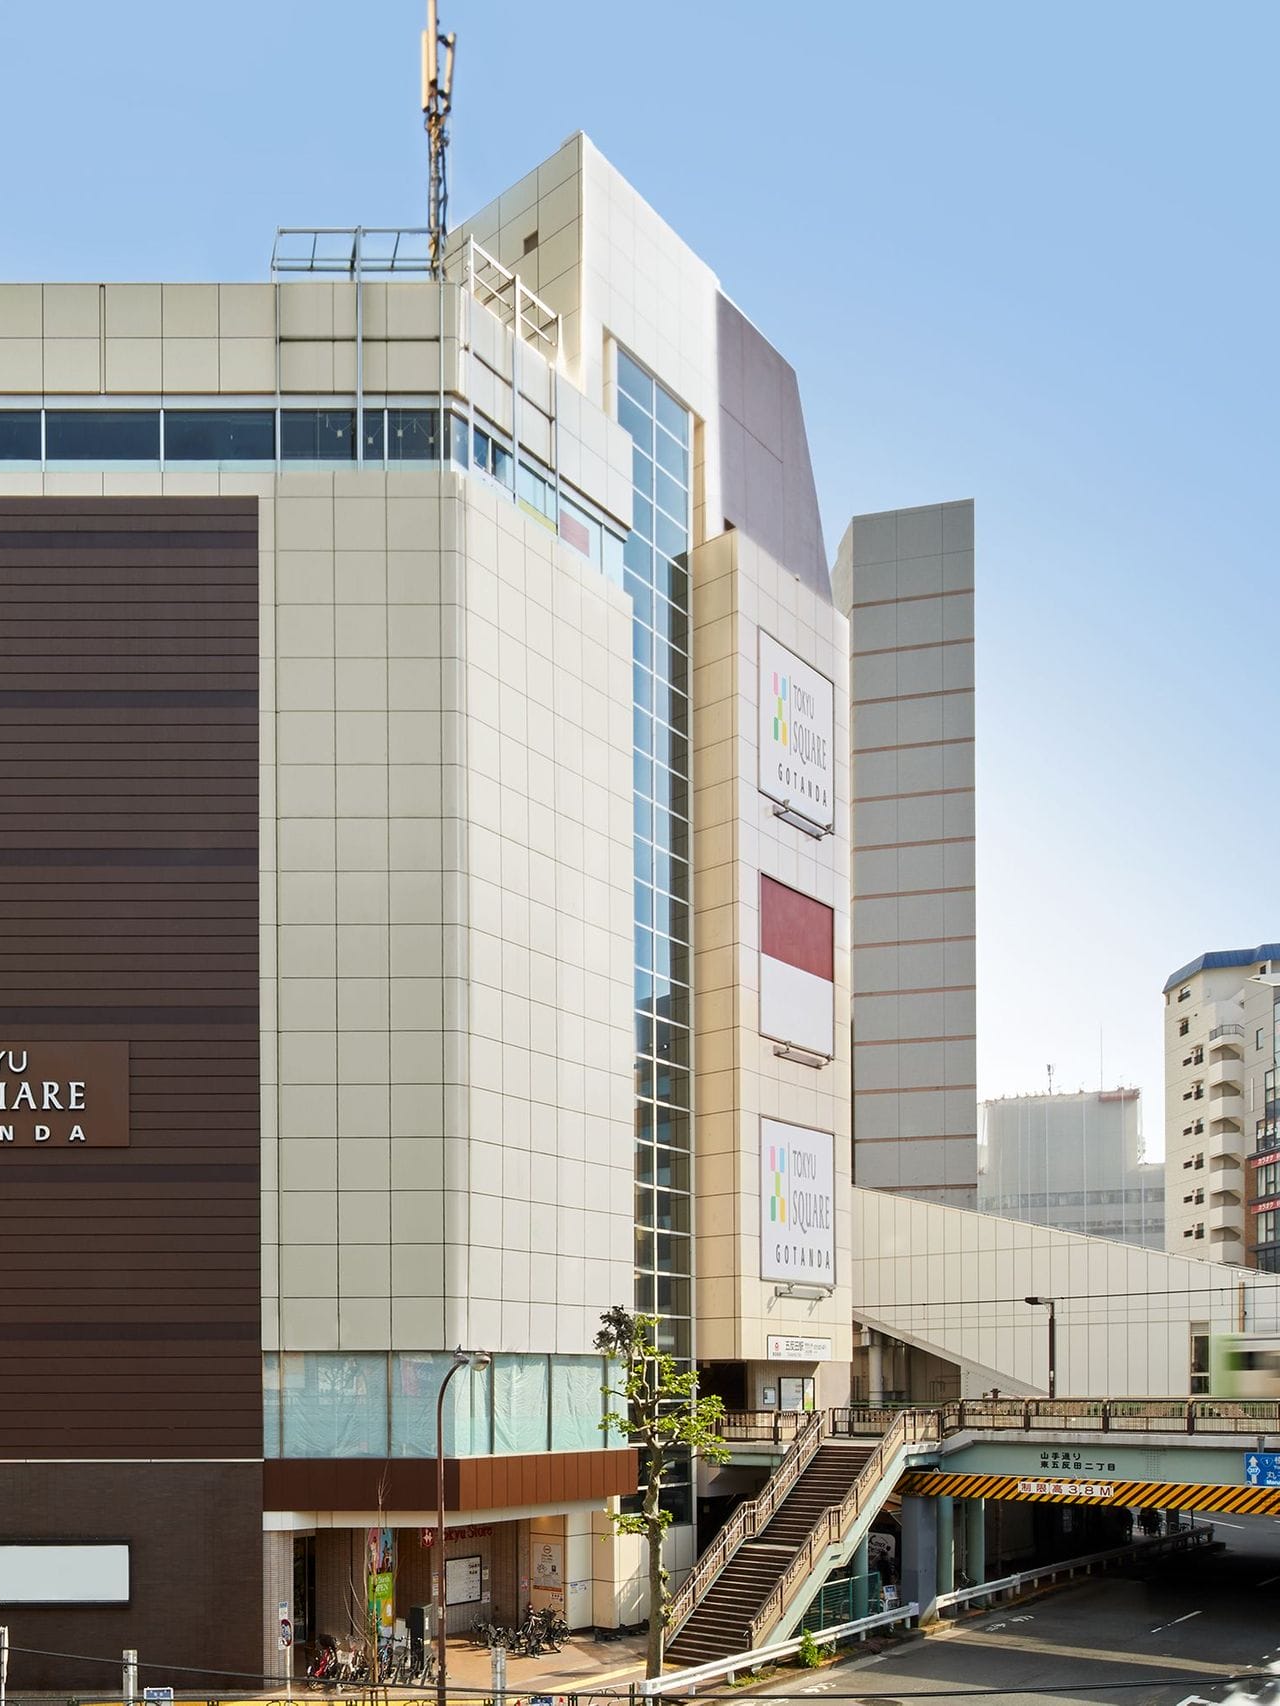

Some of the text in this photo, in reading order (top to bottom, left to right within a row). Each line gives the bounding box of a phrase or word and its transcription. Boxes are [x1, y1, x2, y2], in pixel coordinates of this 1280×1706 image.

[793, 685, 815, 719] TOKYU
[793, 721, 827, 770] SQUARE
[778, 763, 827, 807] GOTANDA
[793, 1150, 816, 1180] TOKYU
[792, 1190, 830, 1234] SQUARE
[776, 1244, 831, 1270] GOTANDA
[1040, 1452, 1081, 1460] 山手通り
[1040, 1461, 1116, 1471] 東五反田二丁目
